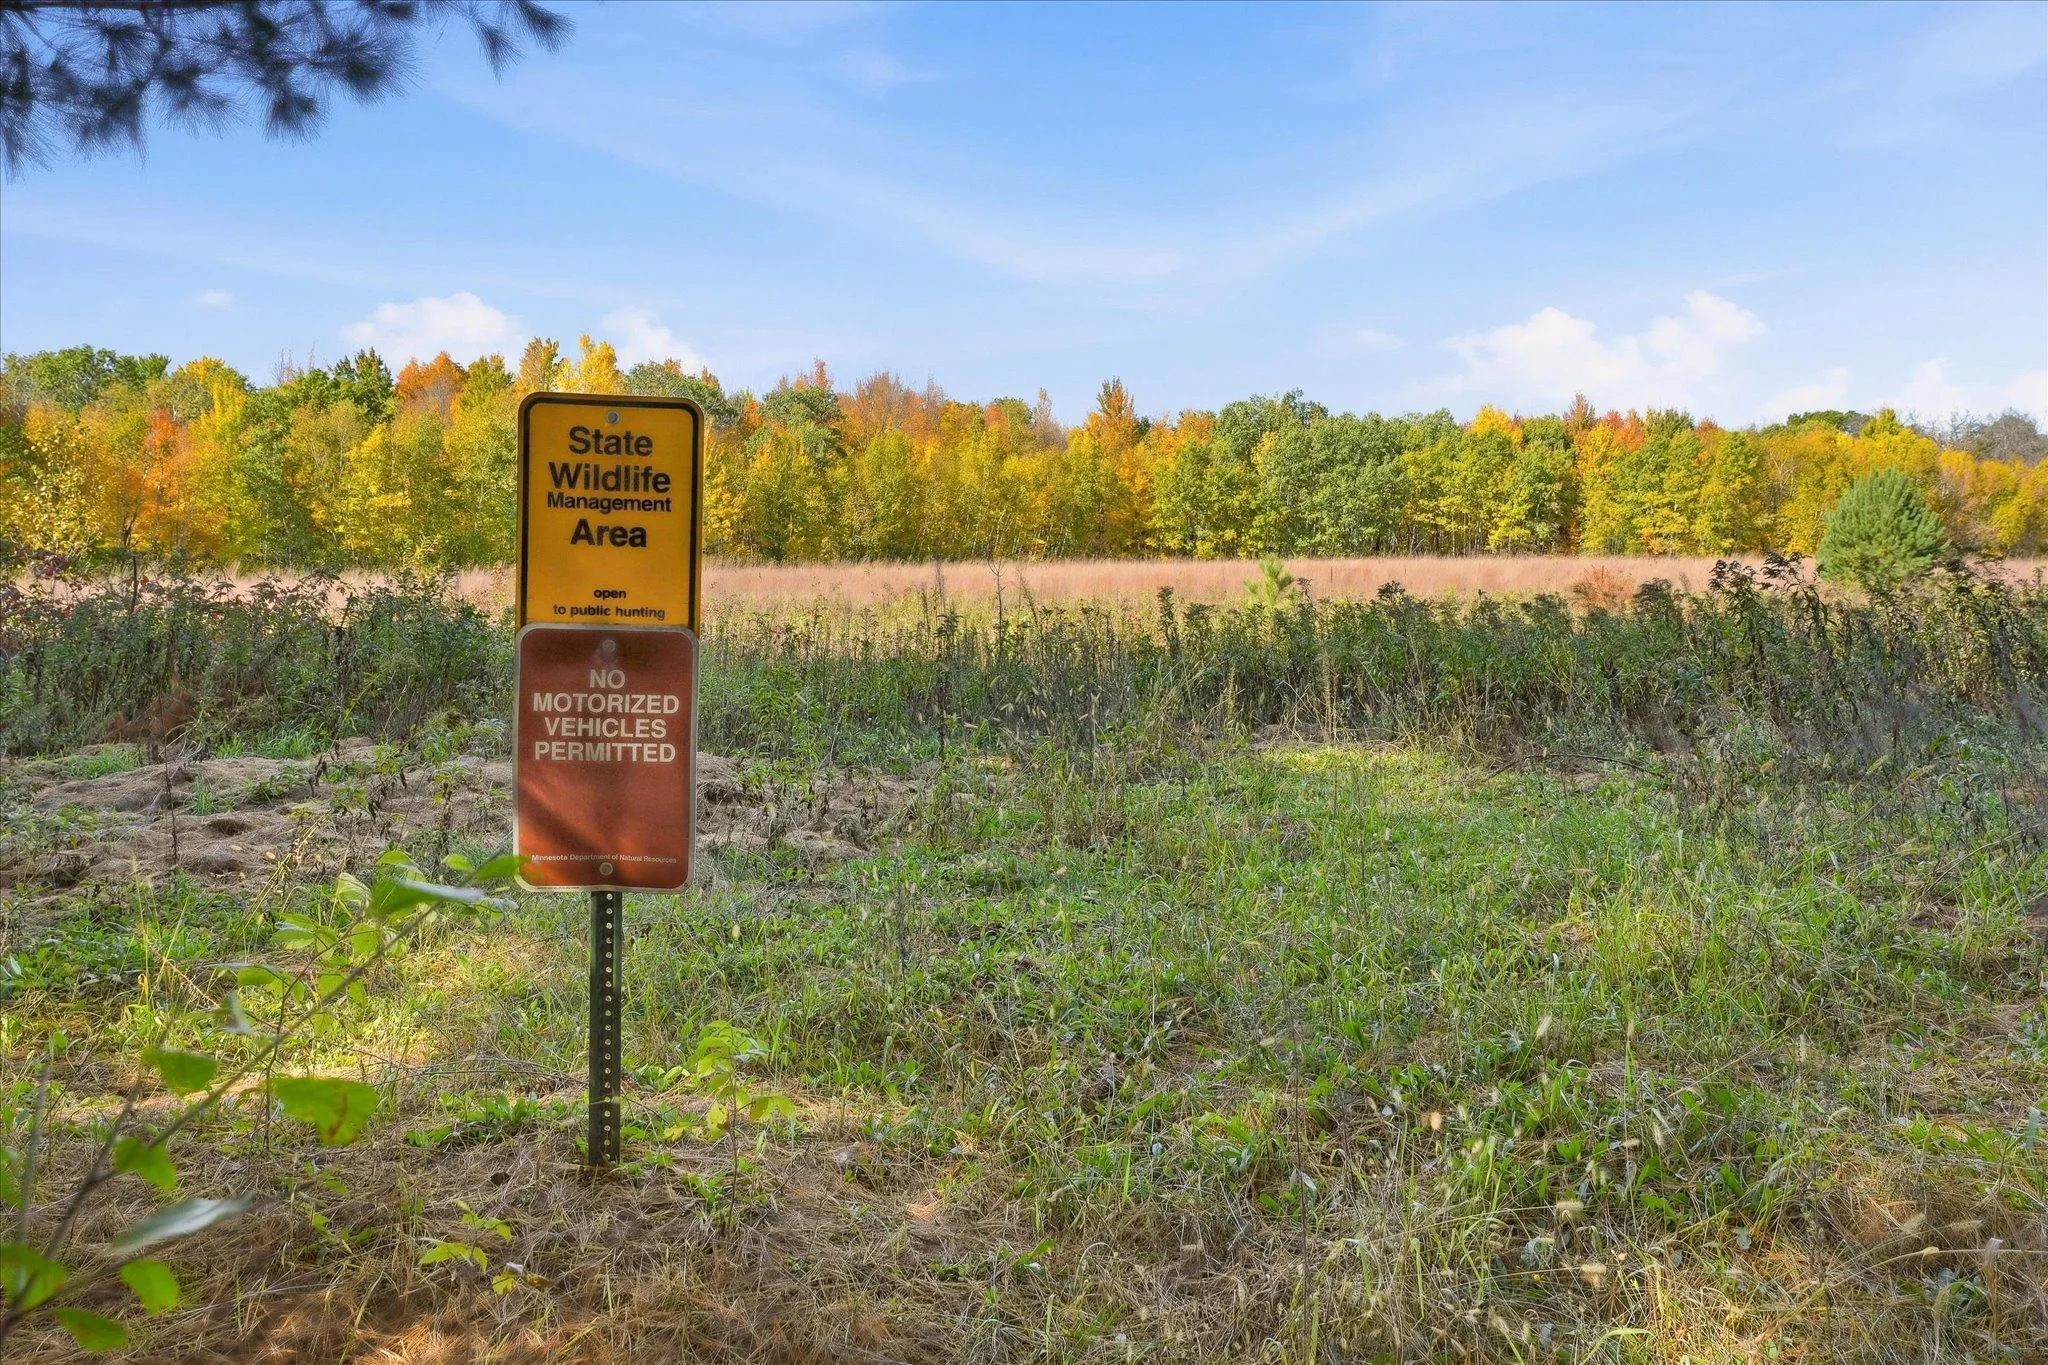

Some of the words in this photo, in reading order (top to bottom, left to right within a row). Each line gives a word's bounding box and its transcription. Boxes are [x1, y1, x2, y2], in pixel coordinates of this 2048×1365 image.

[568, 426, 653, 457] State
[548, 461, 671, 494] Wildlife
[547, 491, 672, 514] Management
[570, 518, 647, 548] Area
[593, 589, 627, 600] open
[553, 605, 567, 616] to
[570, 605, 610, 618] public
[615, 606, 665, 621] hunting
[589, 669, 626, 689] NO
[532, 692, 680, 714] MOTORIZED
[544, 717, 667, 739] VEHICLES
[534, 741, 676, 763] PERMITTED
[619, 854, 643, 862] Natural
[643, 855, 677, 863] Resources
